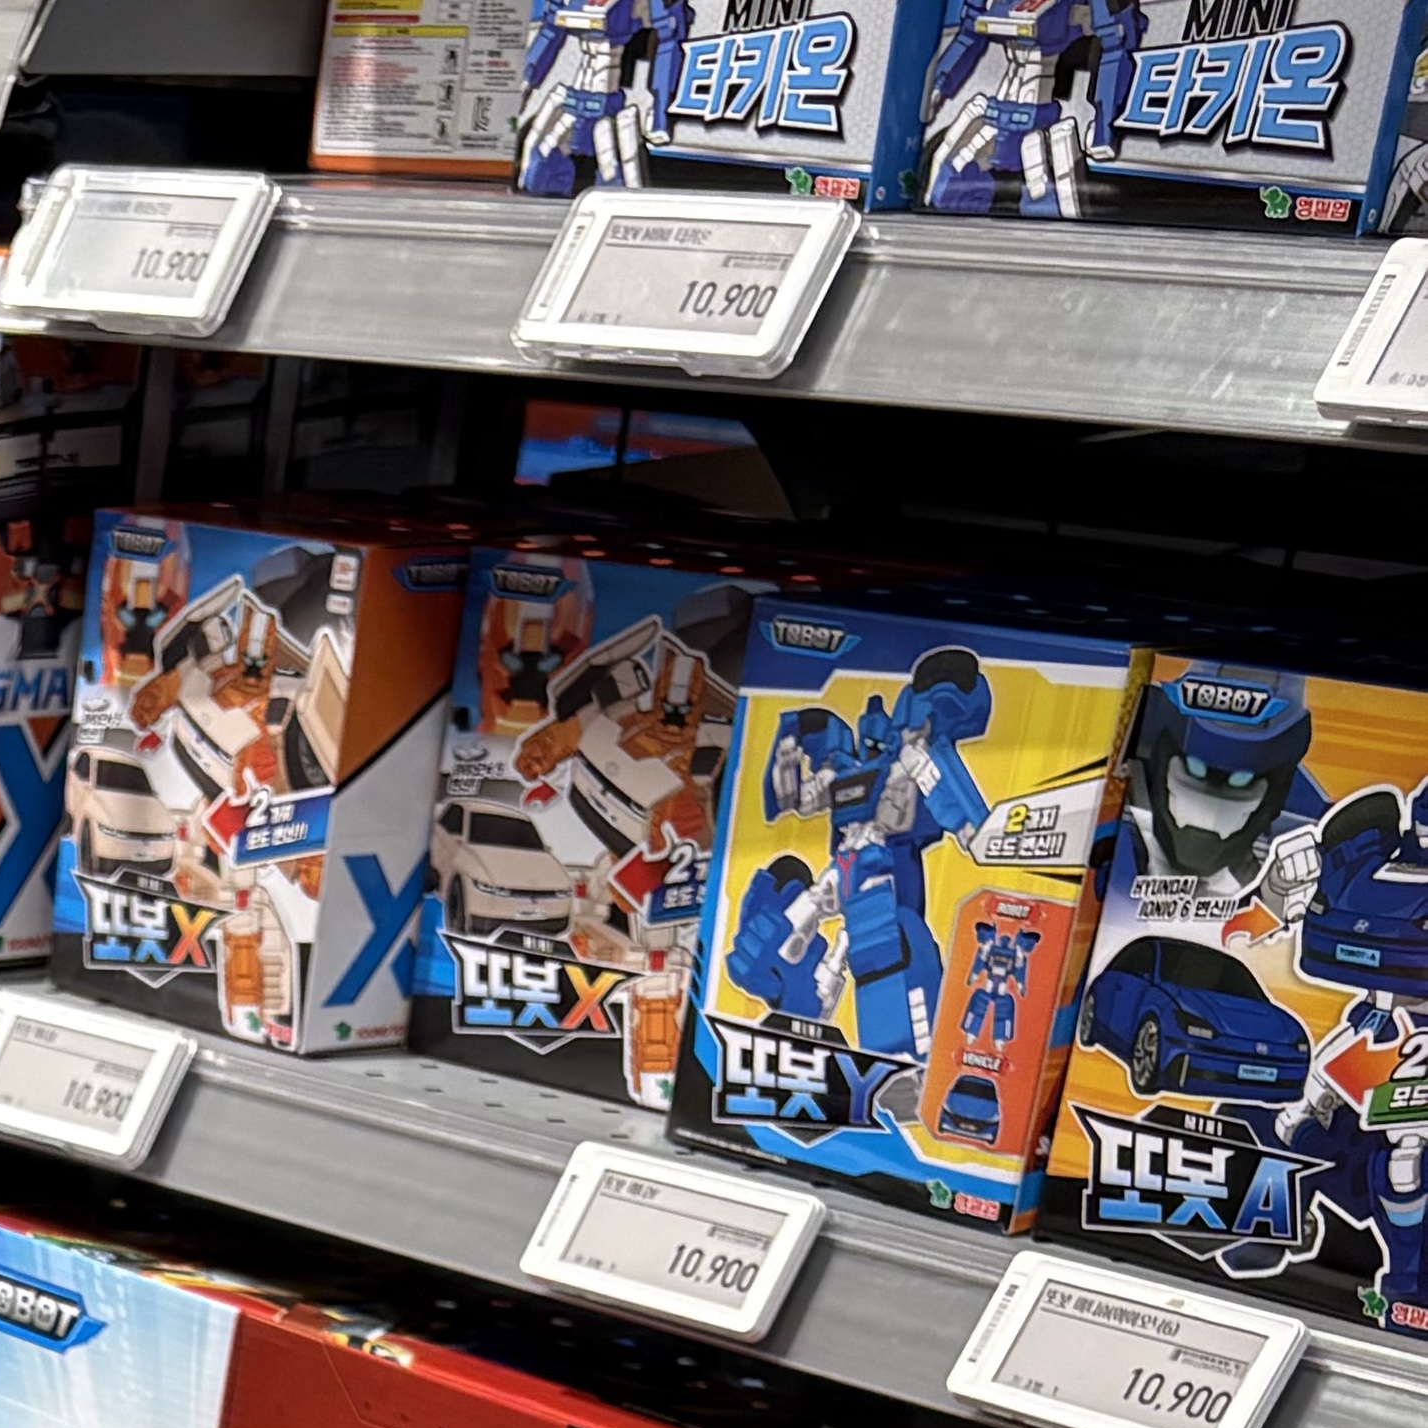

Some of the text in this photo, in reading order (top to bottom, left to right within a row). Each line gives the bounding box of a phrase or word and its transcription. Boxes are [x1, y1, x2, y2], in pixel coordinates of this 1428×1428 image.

[675, 18, 849, 130] 타키온
[1119, 26, 1343, 146] 타키온
[679, 279, 777, 319] 10,900
[772, 619, 845, 652] TOBOT
[1182, 680, 1269, 716] TOBOT
[987, 835, 1018, 858] 모드
[1131, 876, 1197, 899] HYUNDAI
[82, 884, 217, 966] 또봇 X
[451, 941, 627, 1031] 또봇 X
[720, 1022, 898, 1124] 또봇 Y
[1184, 1113, 1224, 1137] MINI
[1087, 1115, 1303, 1238] 또봇 A
[667, 1243, 760, 1294] 10,900
[1122, 1368, 1234, 1425] 10,900
